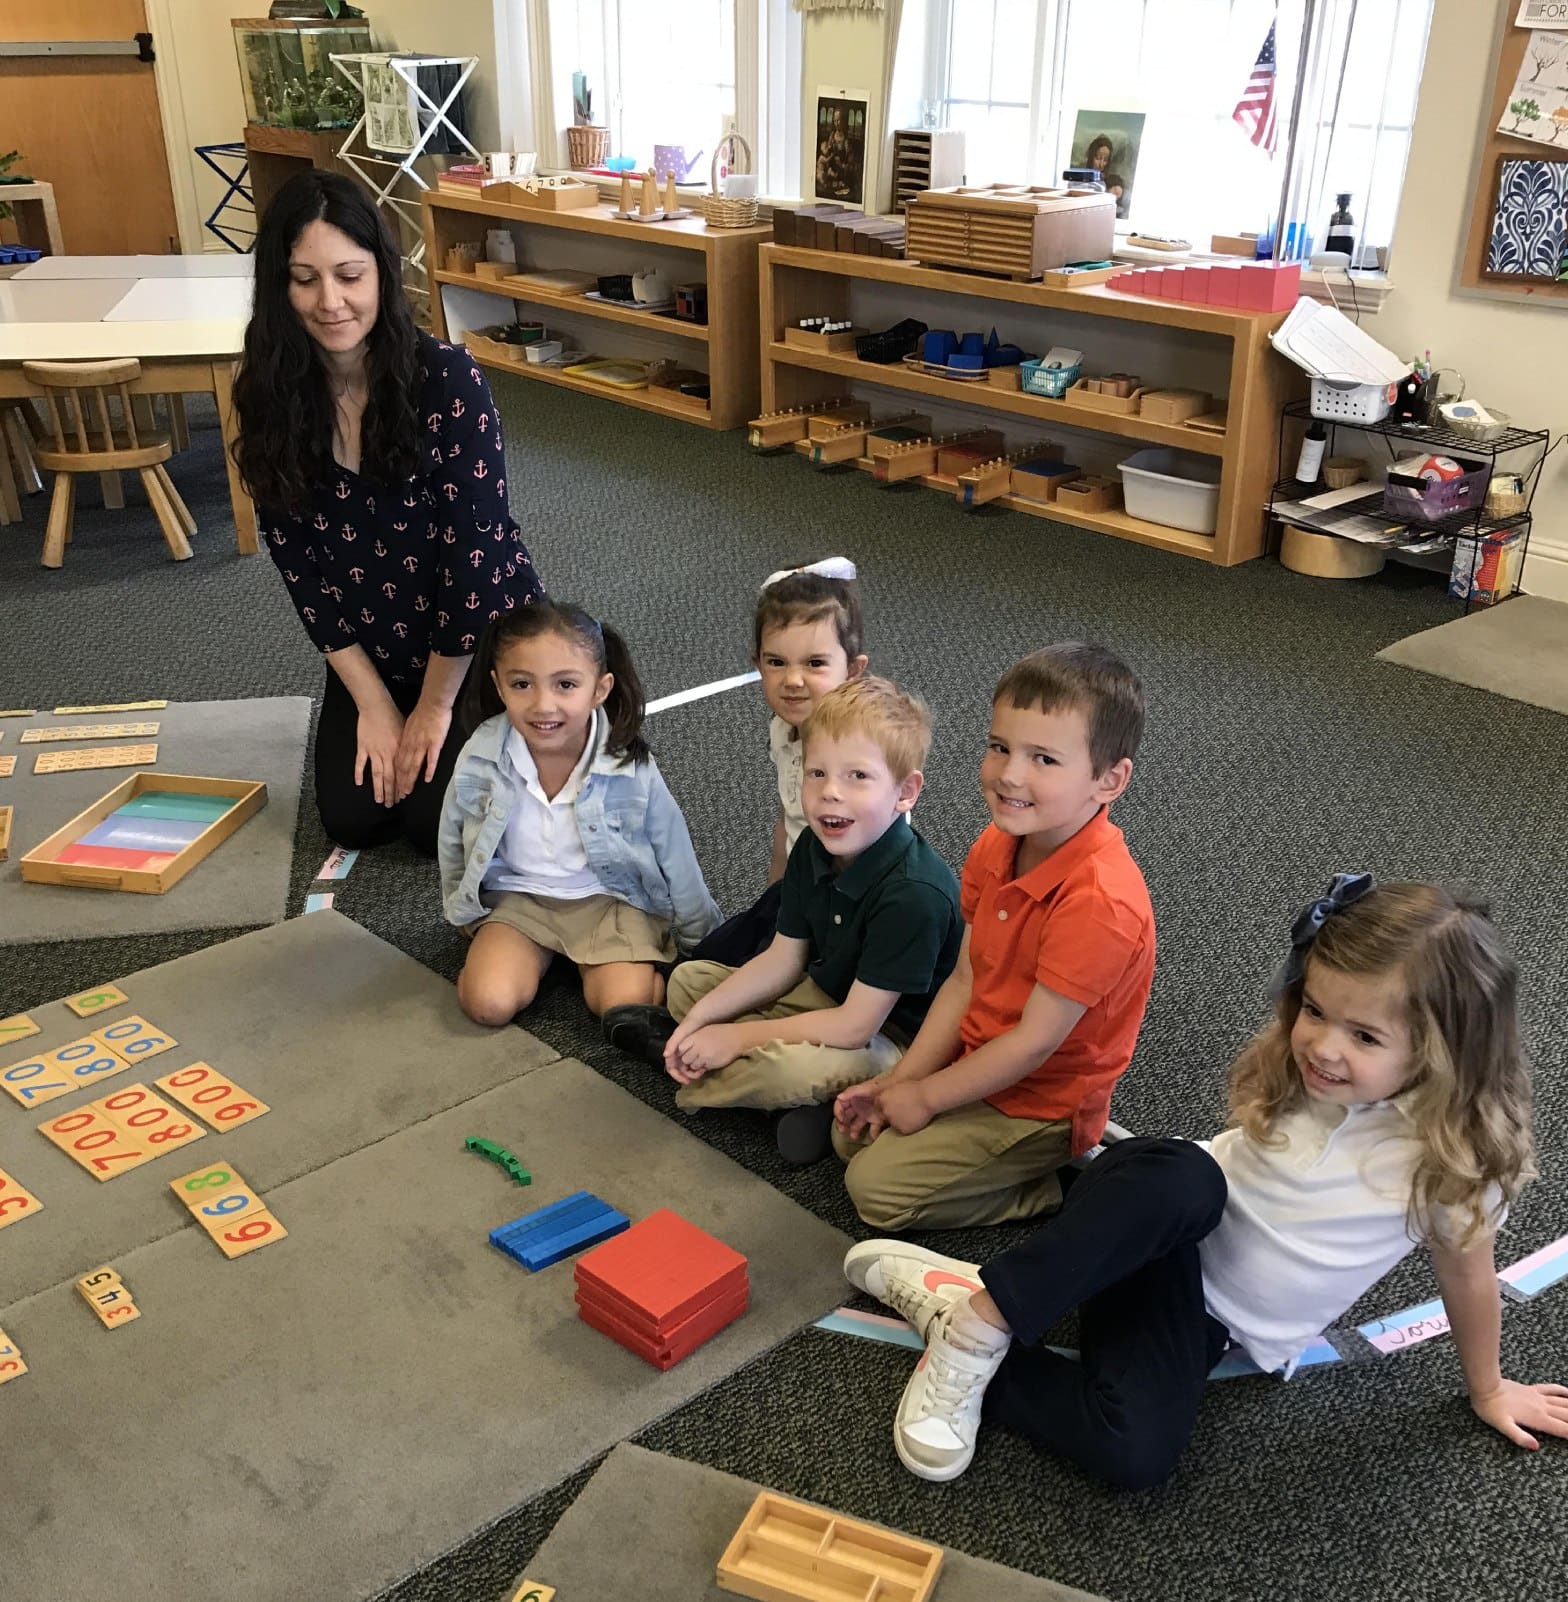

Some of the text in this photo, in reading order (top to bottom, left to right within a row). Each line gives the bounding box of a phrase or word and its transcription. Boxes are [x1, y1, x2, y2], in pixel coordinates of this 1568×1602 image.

[484, 156, 491, 172] 5
[56, 1044, 116, 1076] 80
[4, 1063, 67, 1099] 70
[105, 1091, 192, 1143] 800
[52, 1113, 142, 1171] 700
